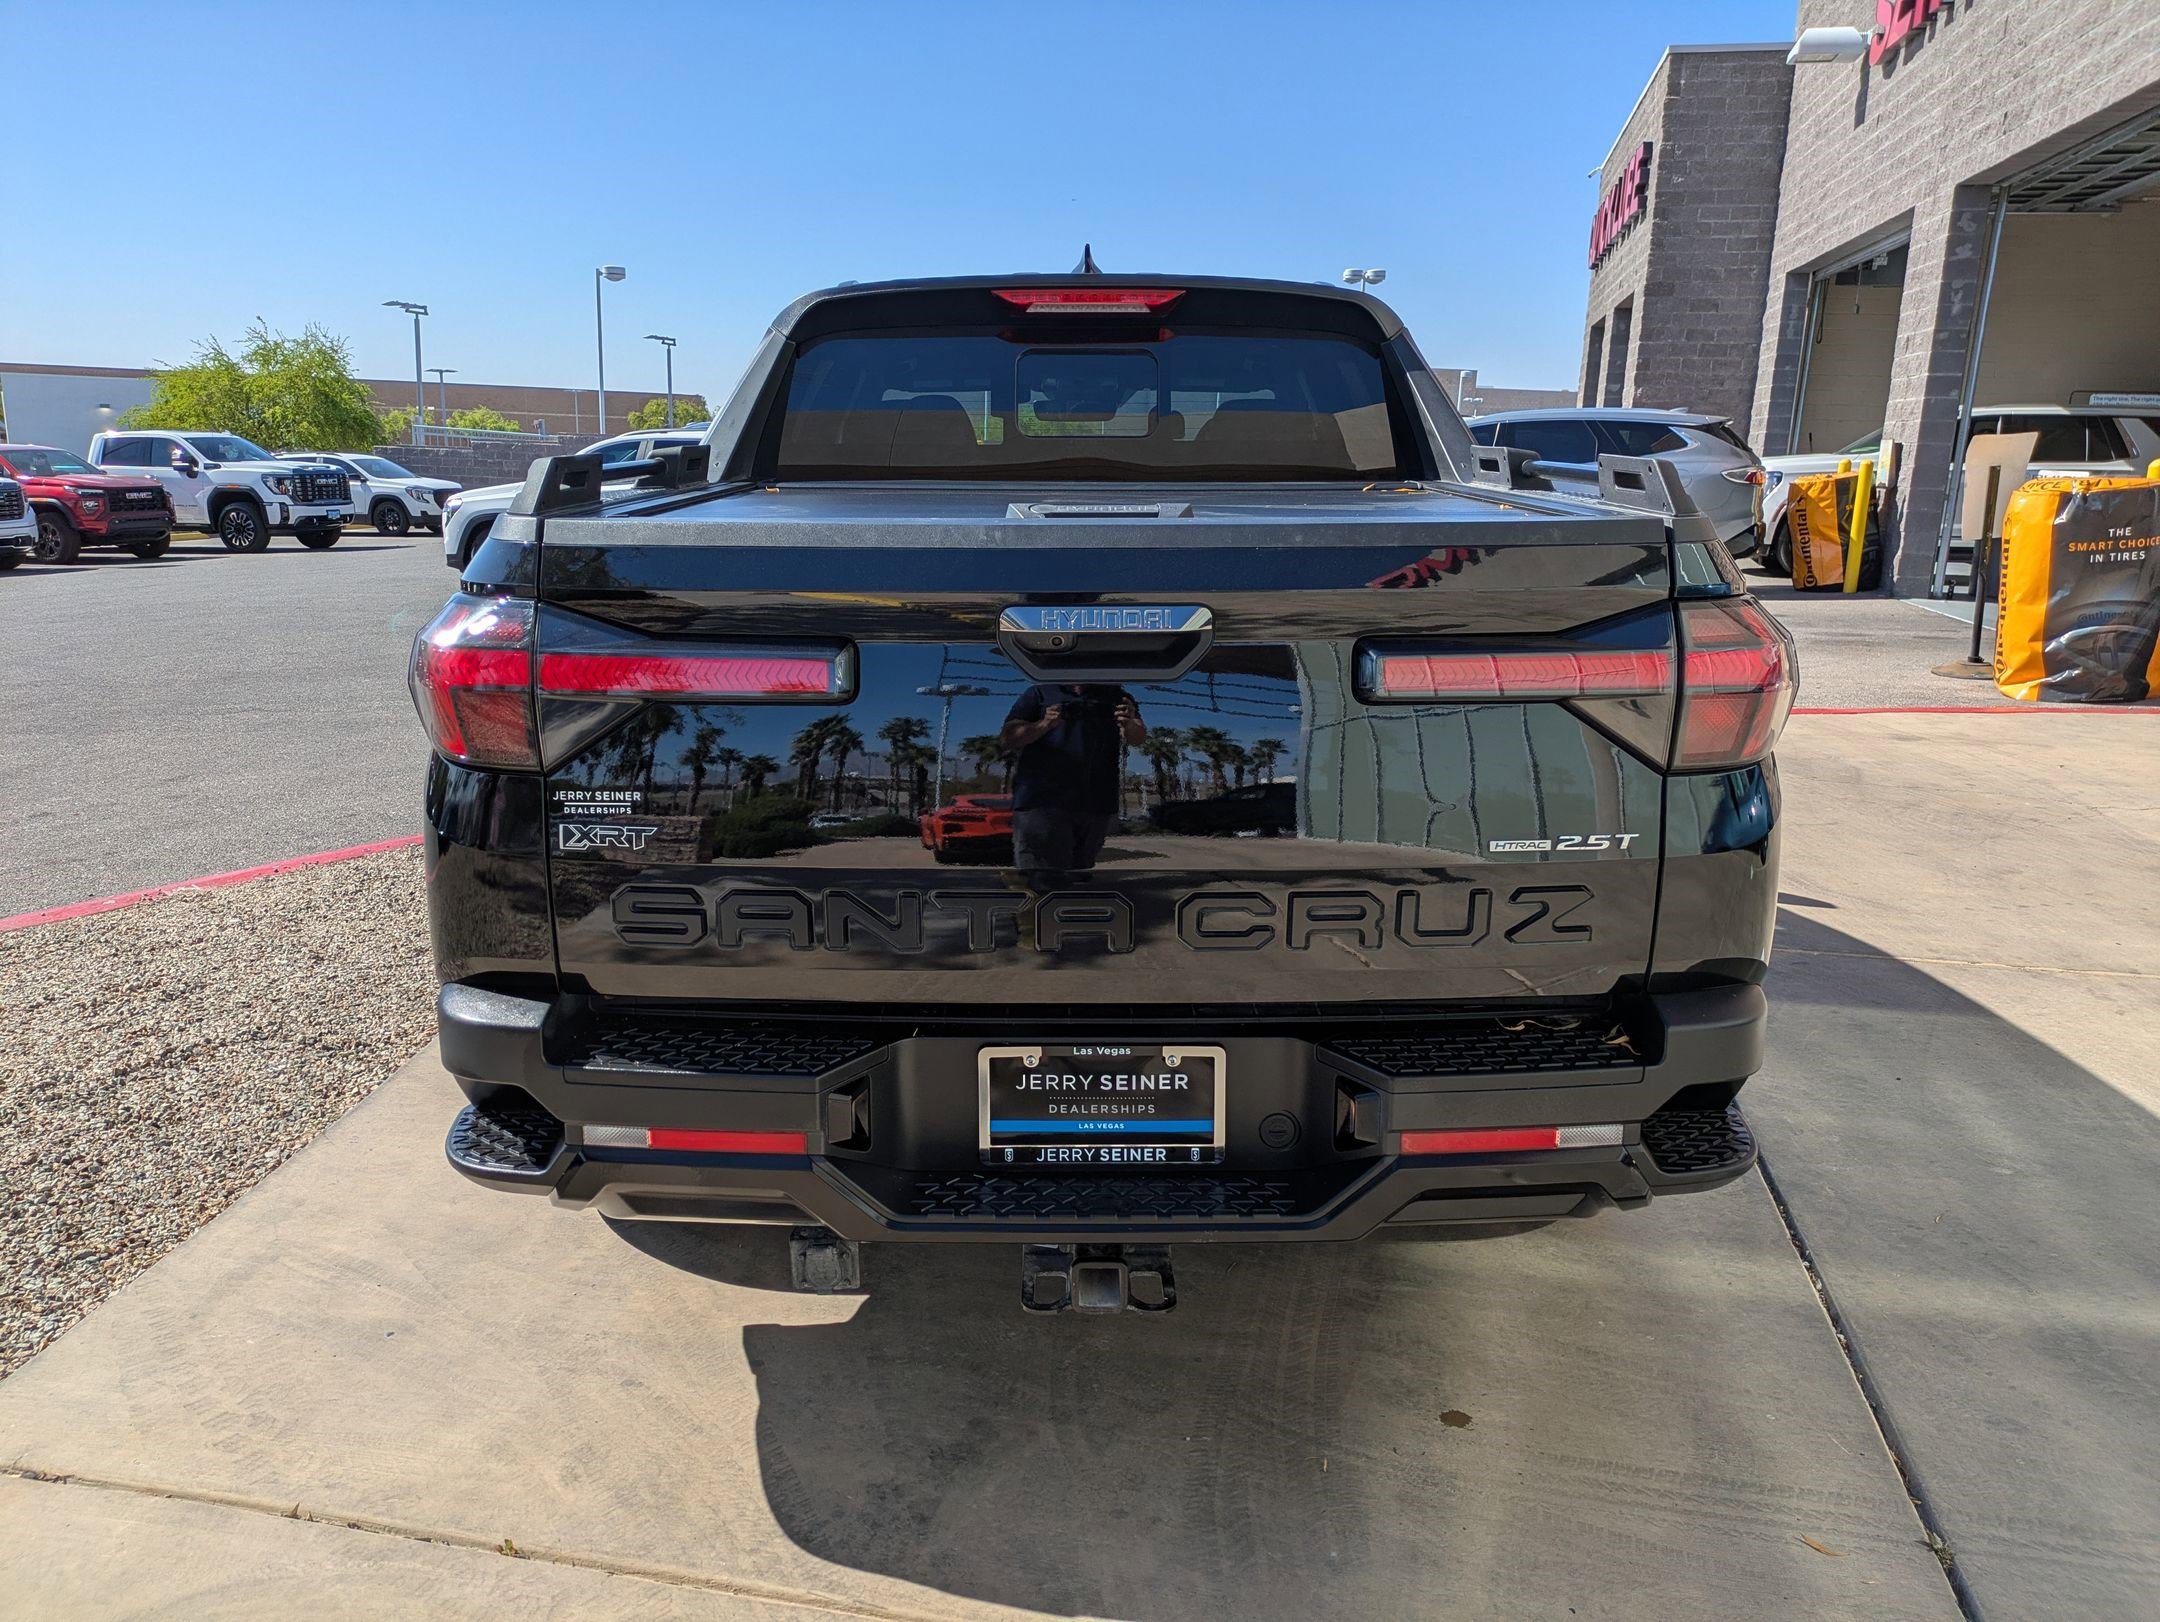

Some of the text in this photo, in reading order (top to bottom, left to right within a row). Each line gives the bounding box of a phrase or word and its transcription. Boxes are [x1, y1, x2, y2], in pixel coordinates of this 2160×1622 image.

[2108, 527, 2132, 537] THE
[2068, 540, 2113, 552] SMART
[2090, 551, 2145, 563] IN TIRES
[1040, 608, 1172, 630] HYUNDAI
[552, 791, 641, 801] JERRY SEINER
[560, 824, 658, 850] XRT
[1494, 841, 1548, 850] HTRAC
[610, 884, 1595, 953] SANTA CRUZ
[1073, 1046, 1131, 1057] Las Vegas
[1015, 1074, 1189, 1091] JERRY SEINER
[1049, 1104, 1156, 1114] DEALERSHIPS
[1036, 1148, 1167, 1162] JERRY SEINER
